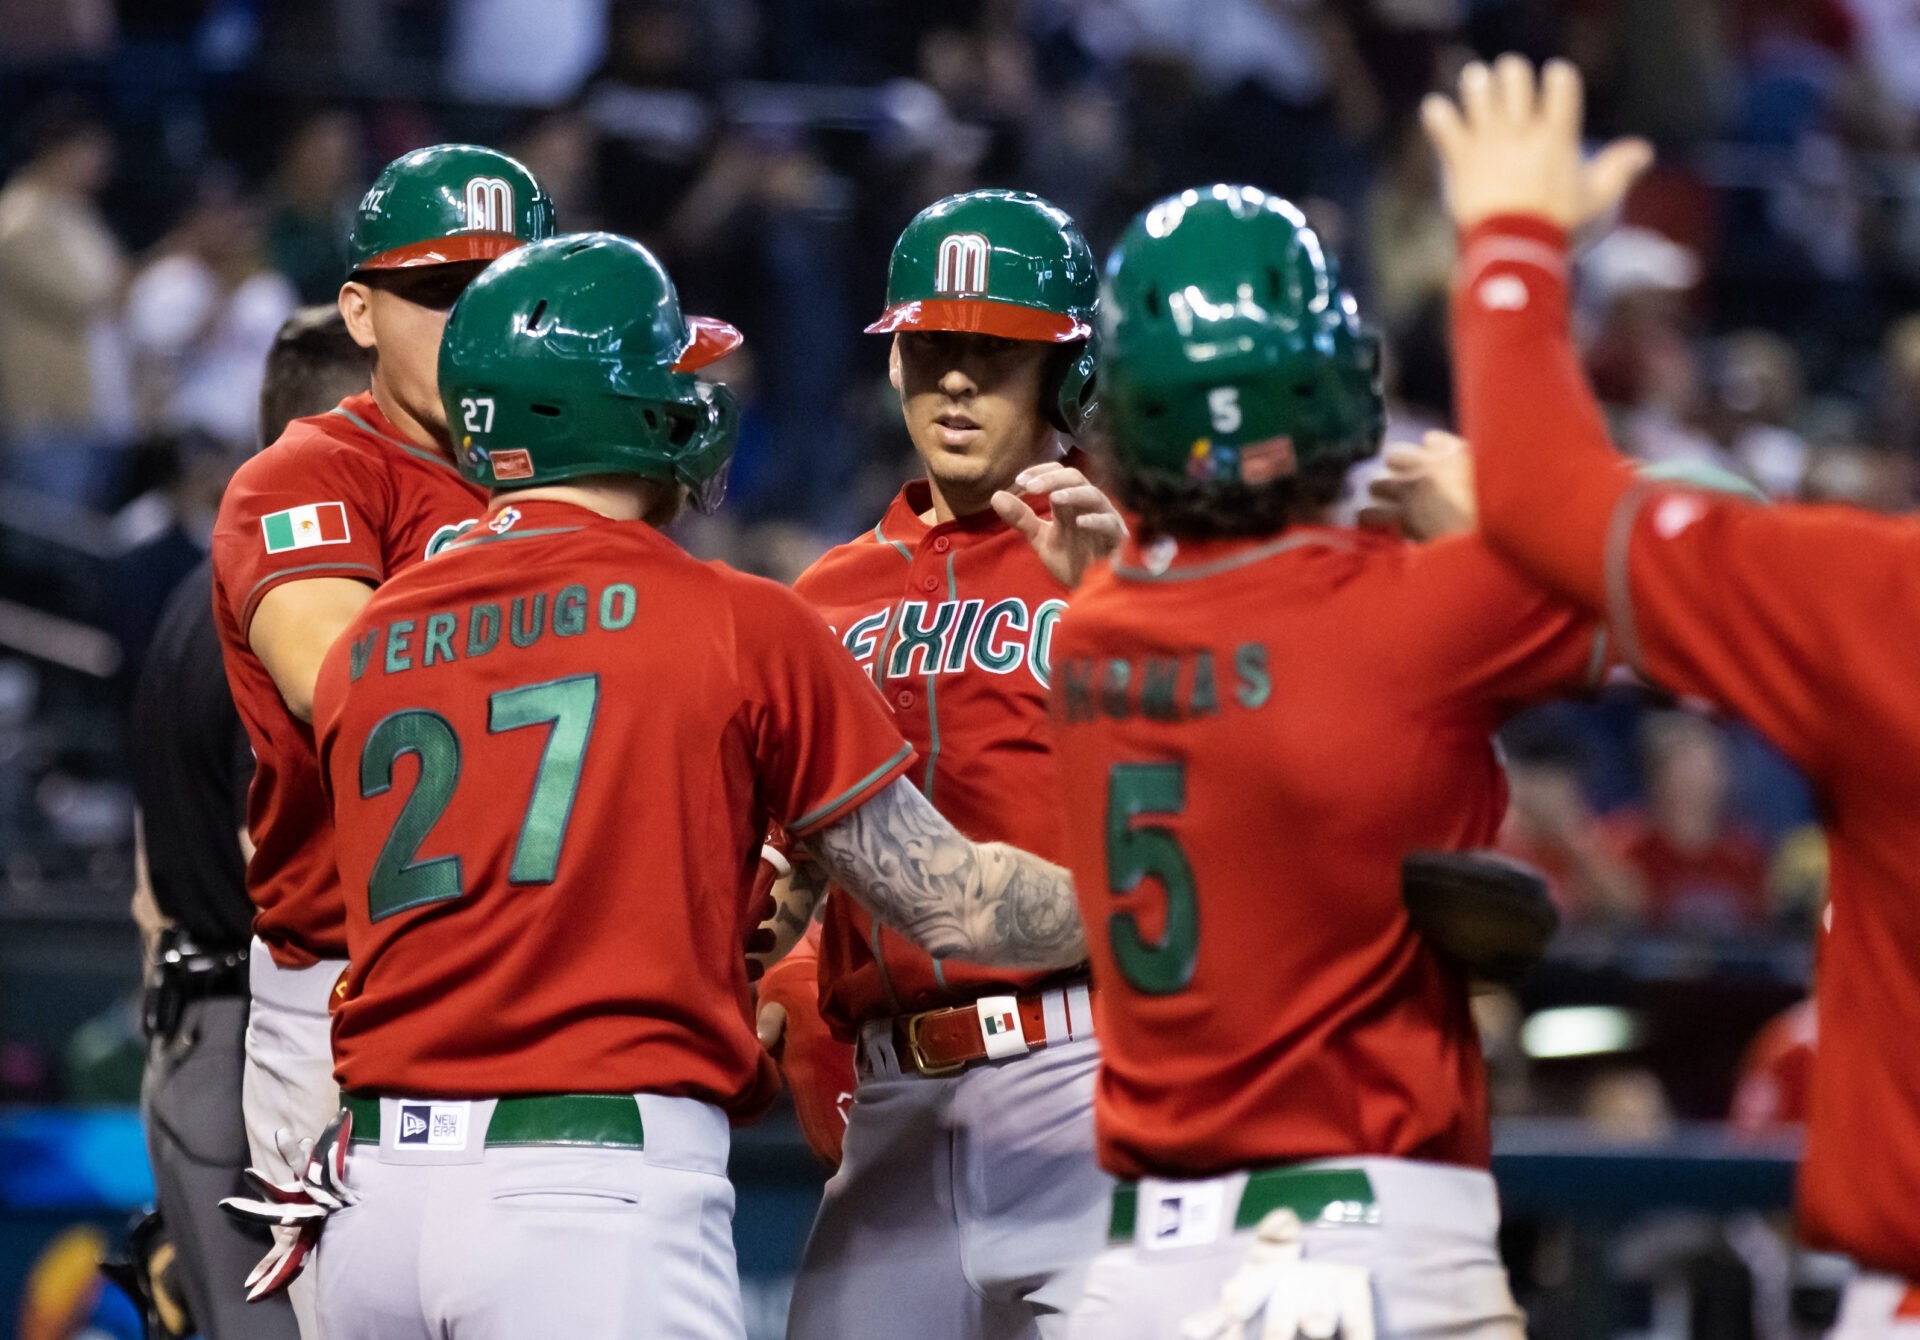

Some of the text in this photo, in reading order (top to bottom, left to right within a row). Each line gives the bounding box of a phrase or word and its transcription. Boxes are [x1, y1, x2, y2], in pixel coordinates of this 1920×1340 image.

[460, 398, 495, 433] 27
[1208, 386, 1242, 434] 5
[350, 582, 637, 684] VERDUGO
[359, 672, 601, 924] 27
[1104, 762, 1201, 997] 5
[433, 1125, 456, 1137] ERA
[434, 1114, 457, 1126] NEW
